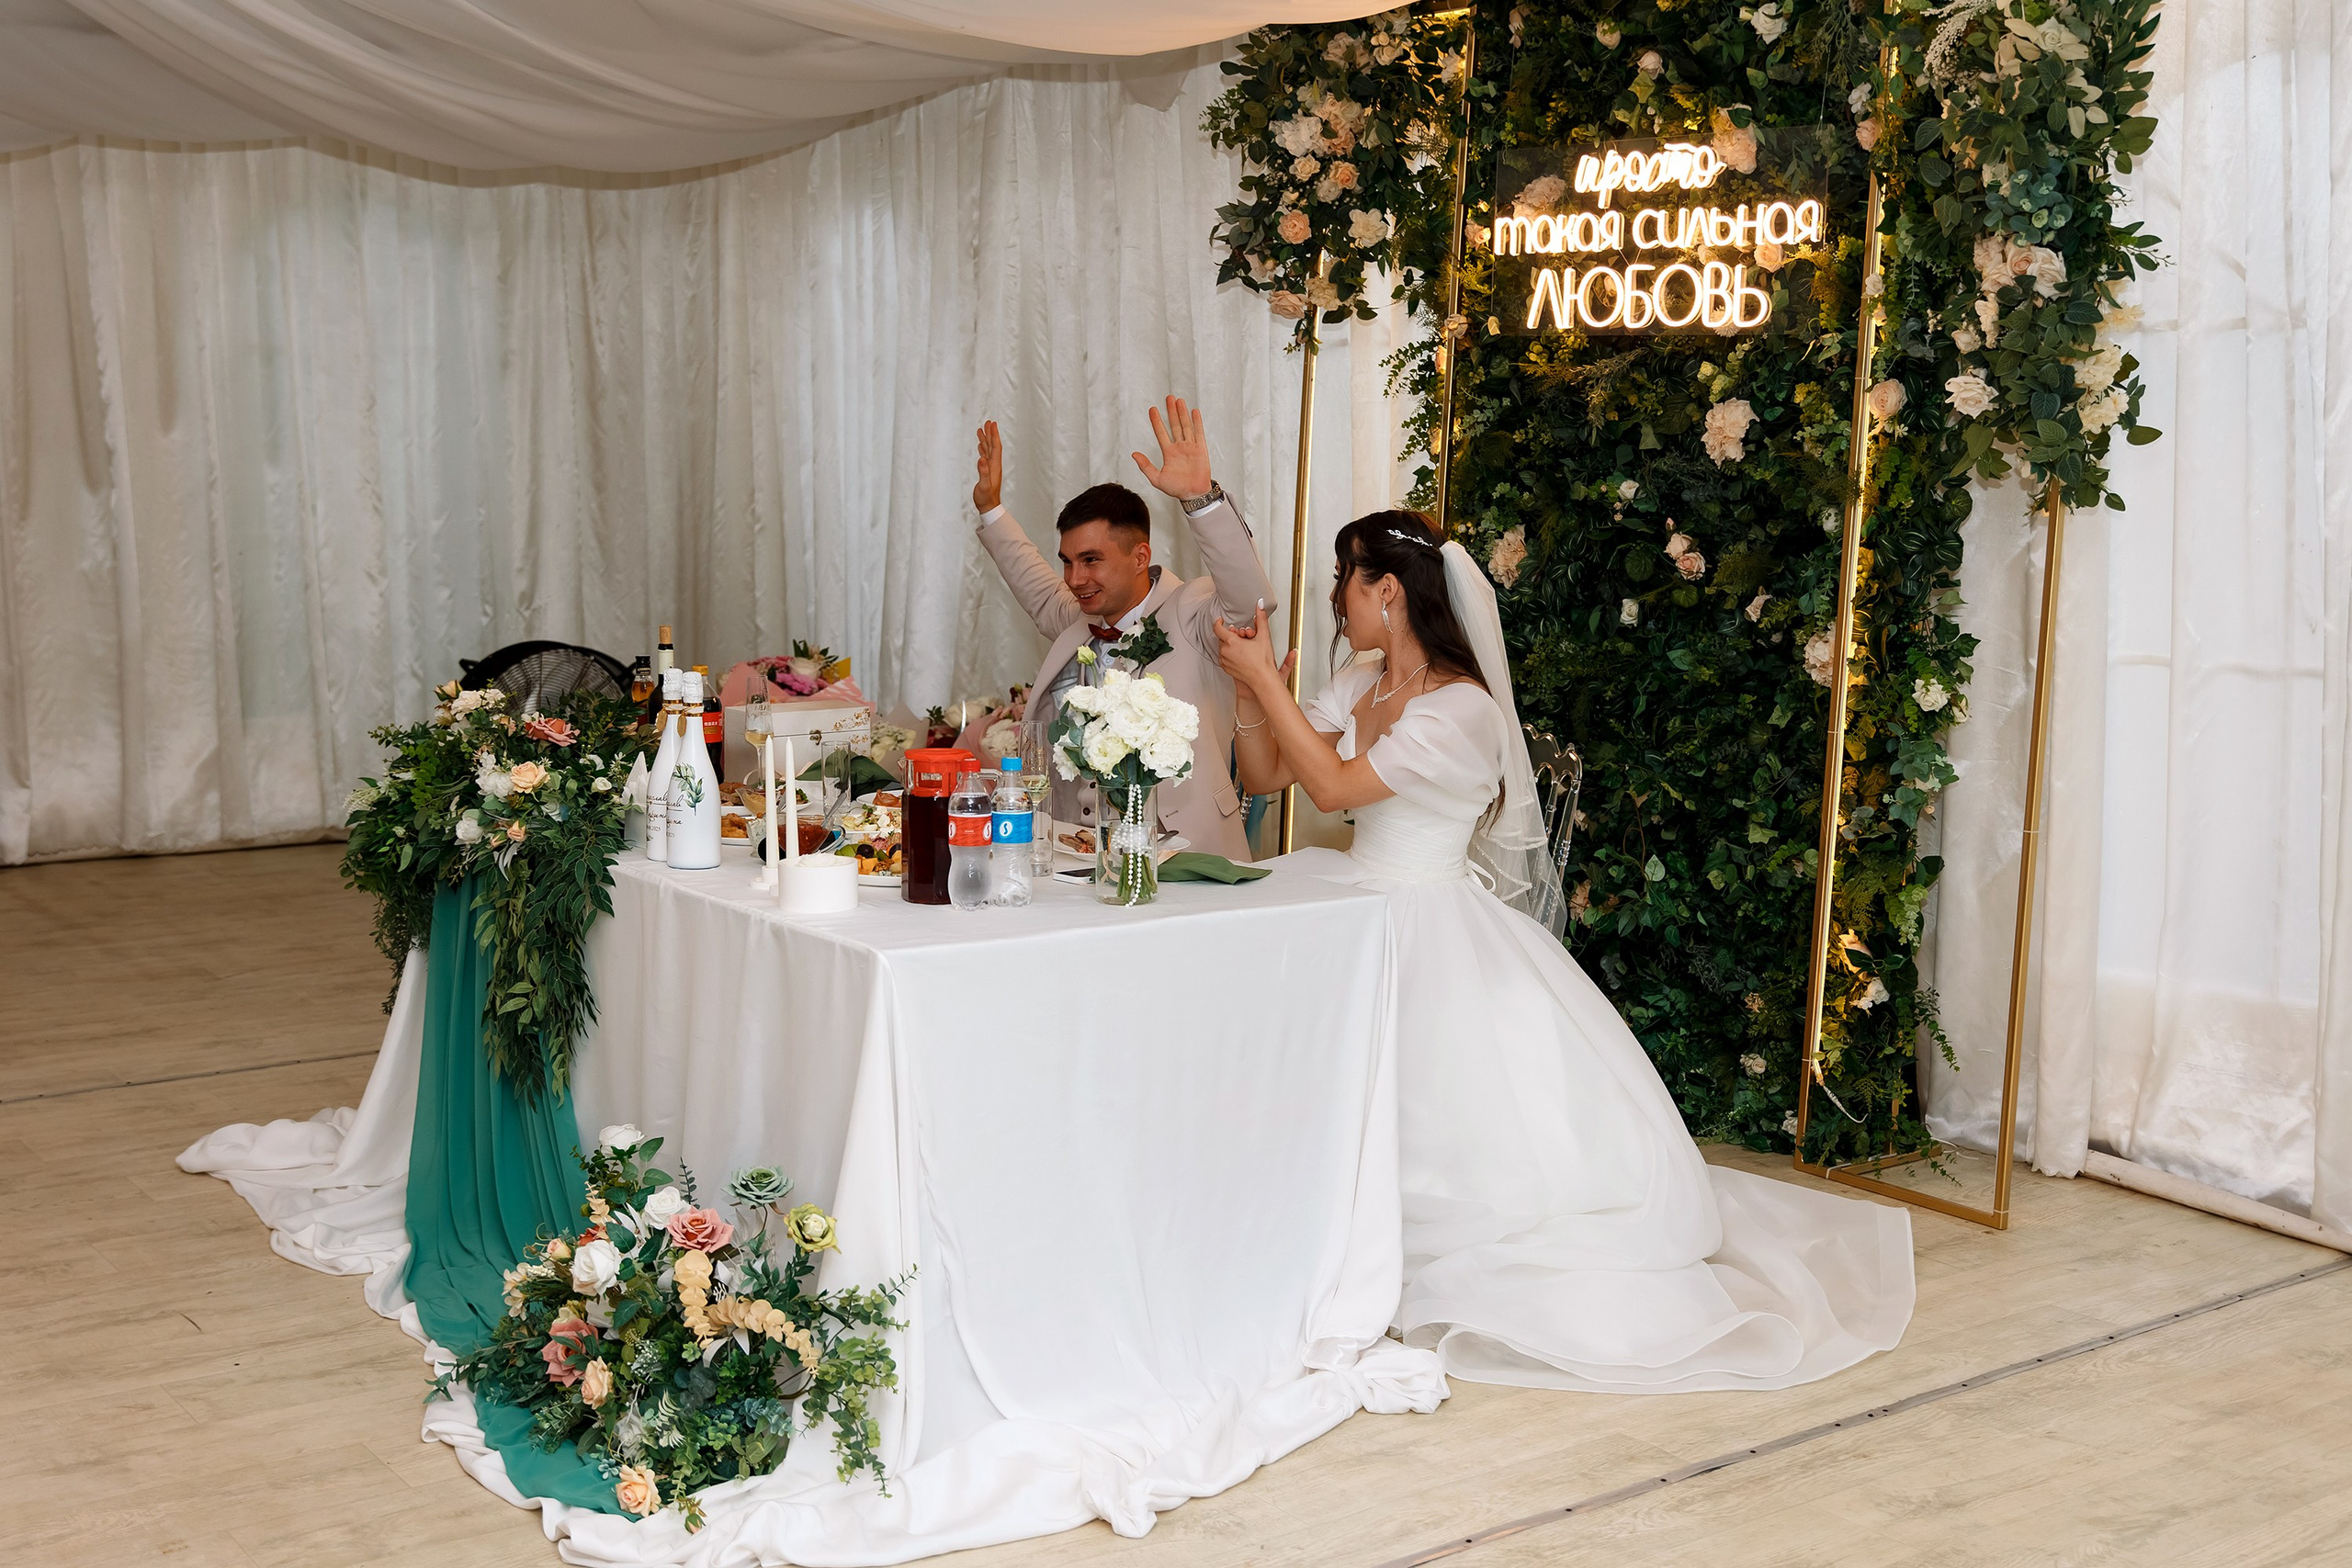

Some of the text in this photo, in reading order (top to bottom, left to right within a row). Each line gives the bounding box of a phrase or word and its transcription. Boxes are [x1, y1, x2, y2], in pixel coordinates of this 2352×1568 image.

[1575, 142, 1727, 209] просто
[1495, 199, 1824, 256] такая сильная
[1527, 261, 1772, 331] ЛЮБОВЬ
